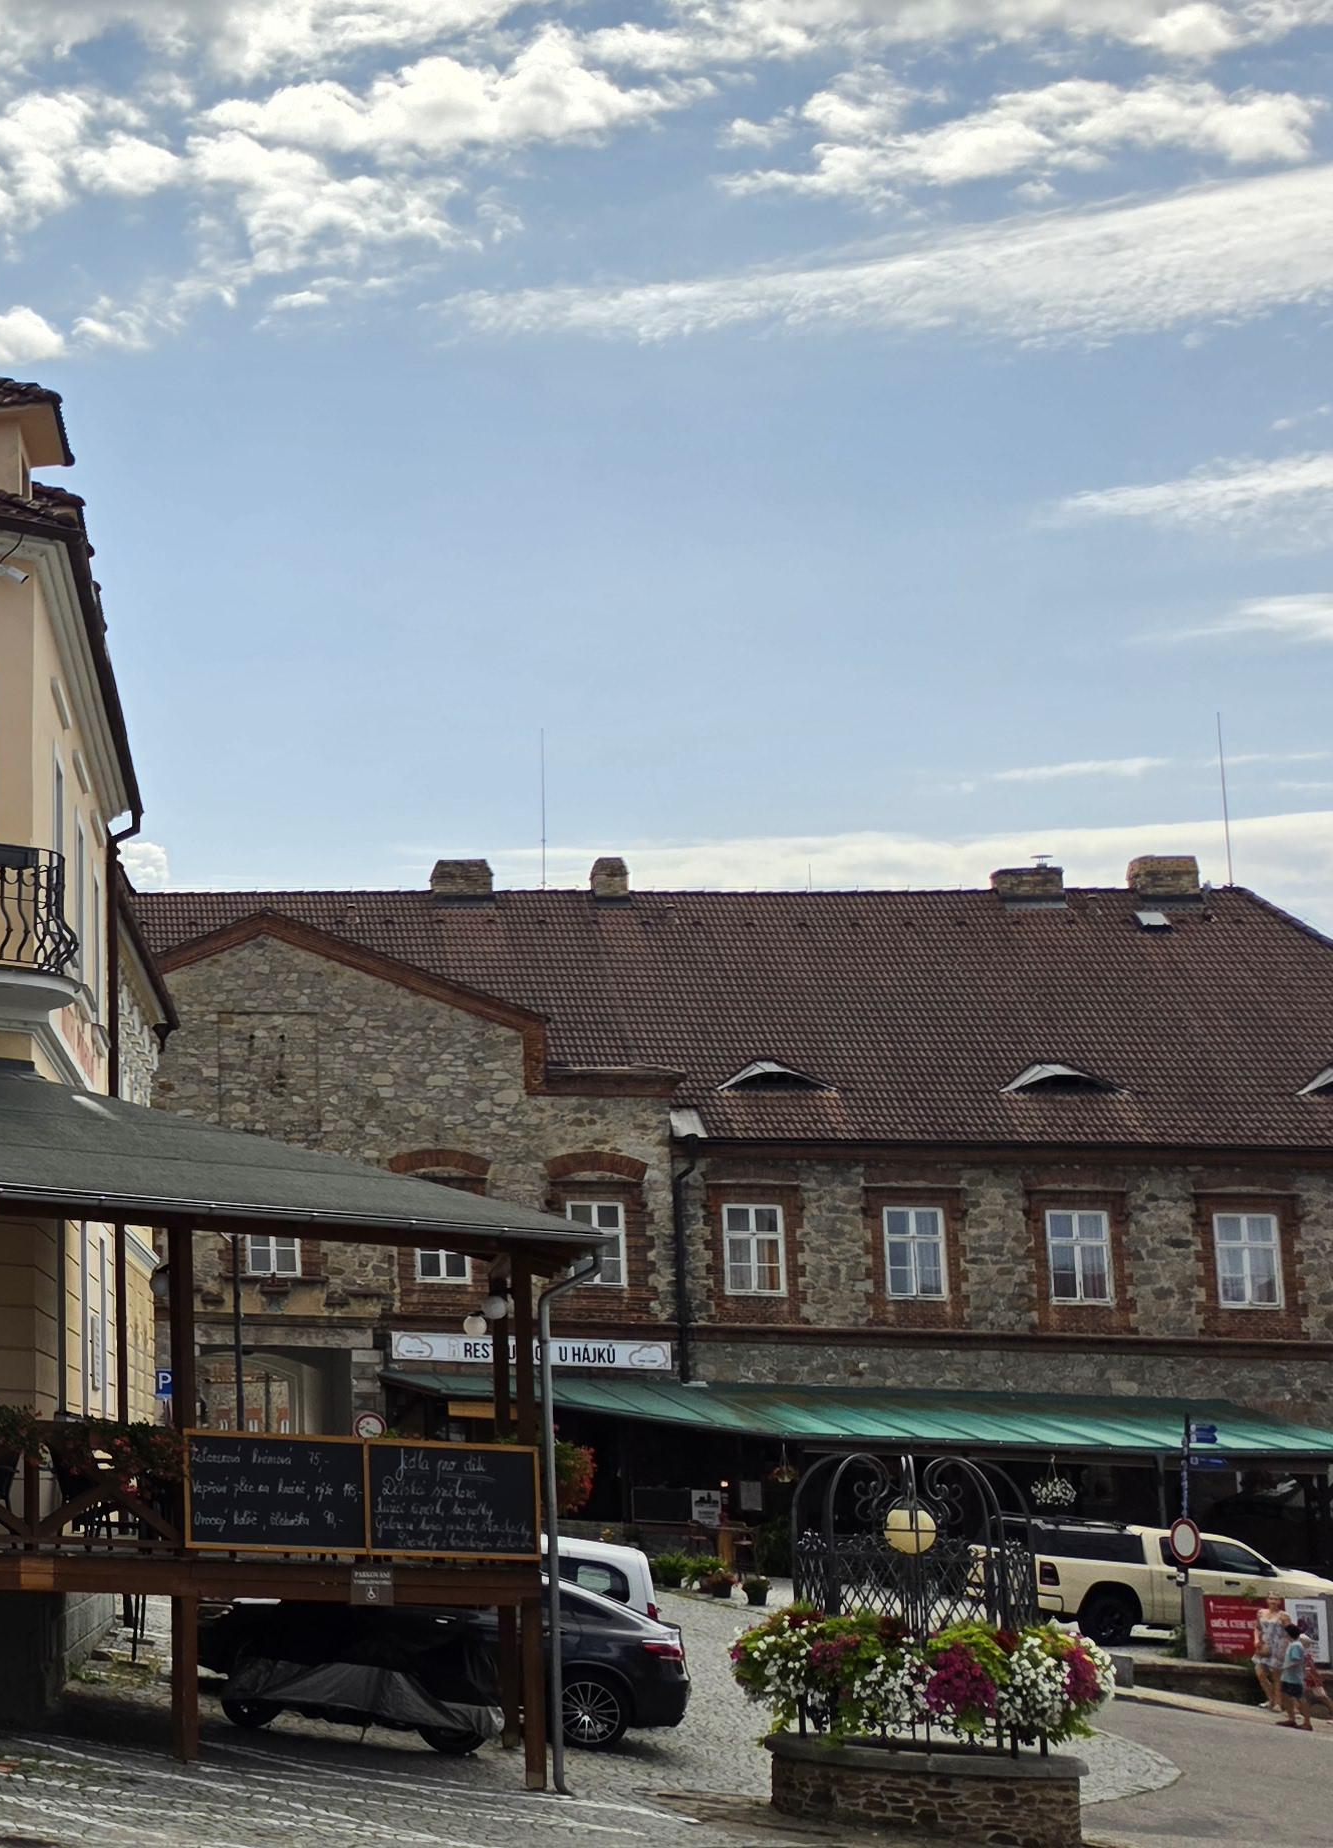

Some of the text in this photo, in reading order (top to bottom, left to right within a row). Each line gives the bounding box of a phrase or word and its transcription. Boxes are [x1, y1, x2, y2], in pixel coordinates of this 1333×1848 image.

[559, 1346, 568, 1362] U
[572, 1343, 616, 1364] HÁJKŮ
[158, 1372, 172, 1391] P
[436, 1459, 457, 1482] pro
